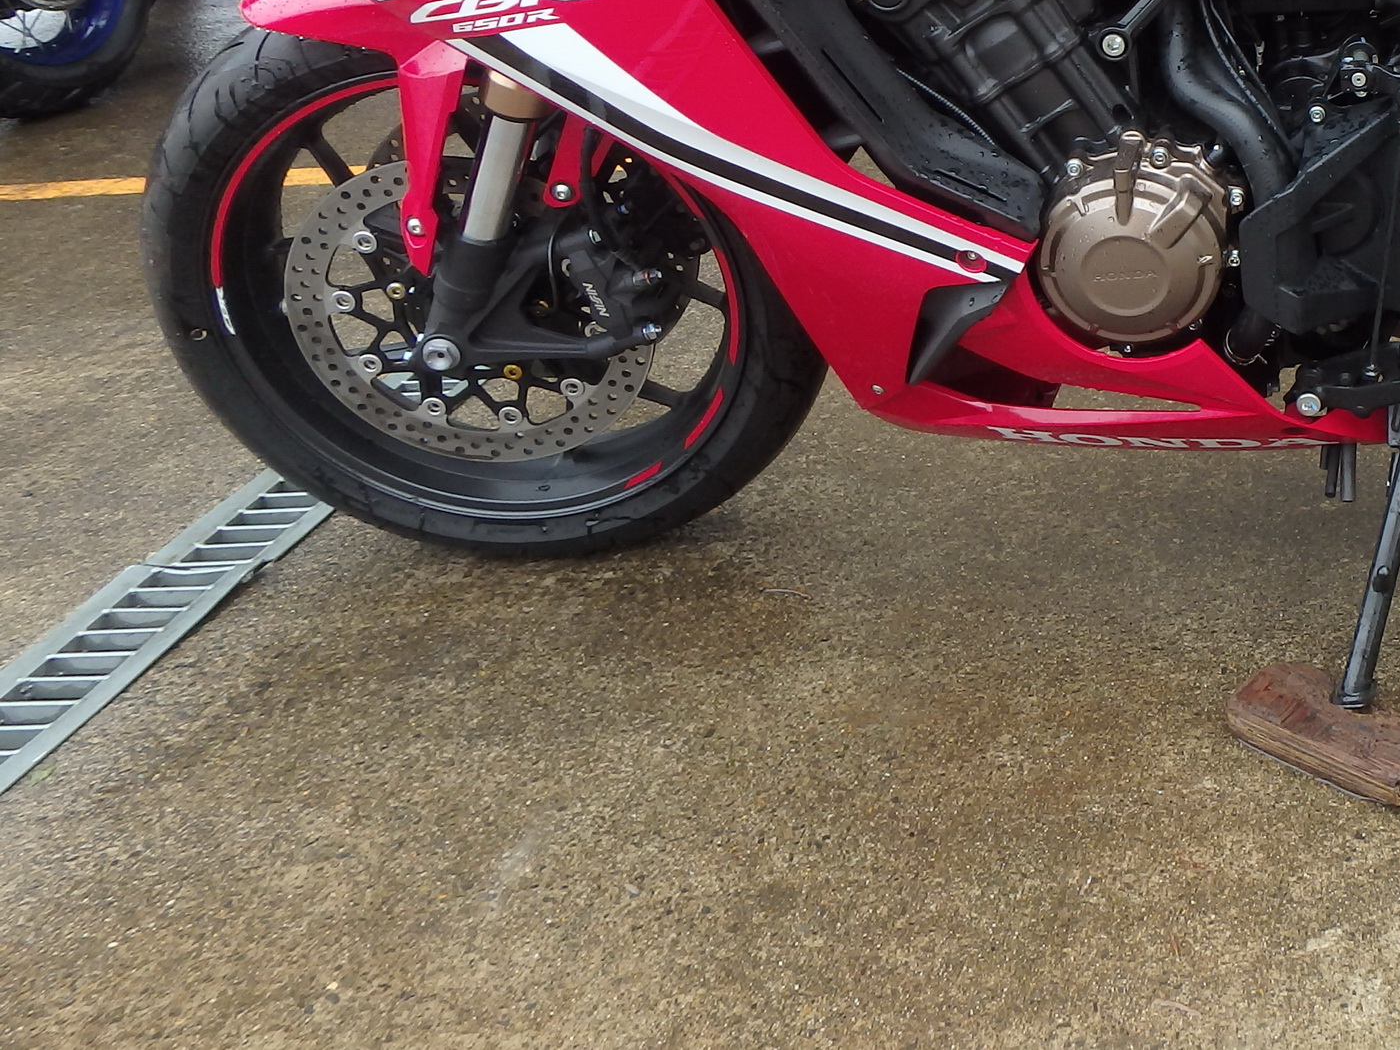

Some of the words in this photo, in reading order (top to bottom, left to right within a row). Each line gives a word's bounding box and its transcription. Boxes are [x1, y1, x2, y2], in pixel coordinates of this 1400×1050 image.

[452, 8, 560, 33] 650R
[1093, 271, 1158, 282] HONDA
[987, 426, 1340, 449] HONDA
